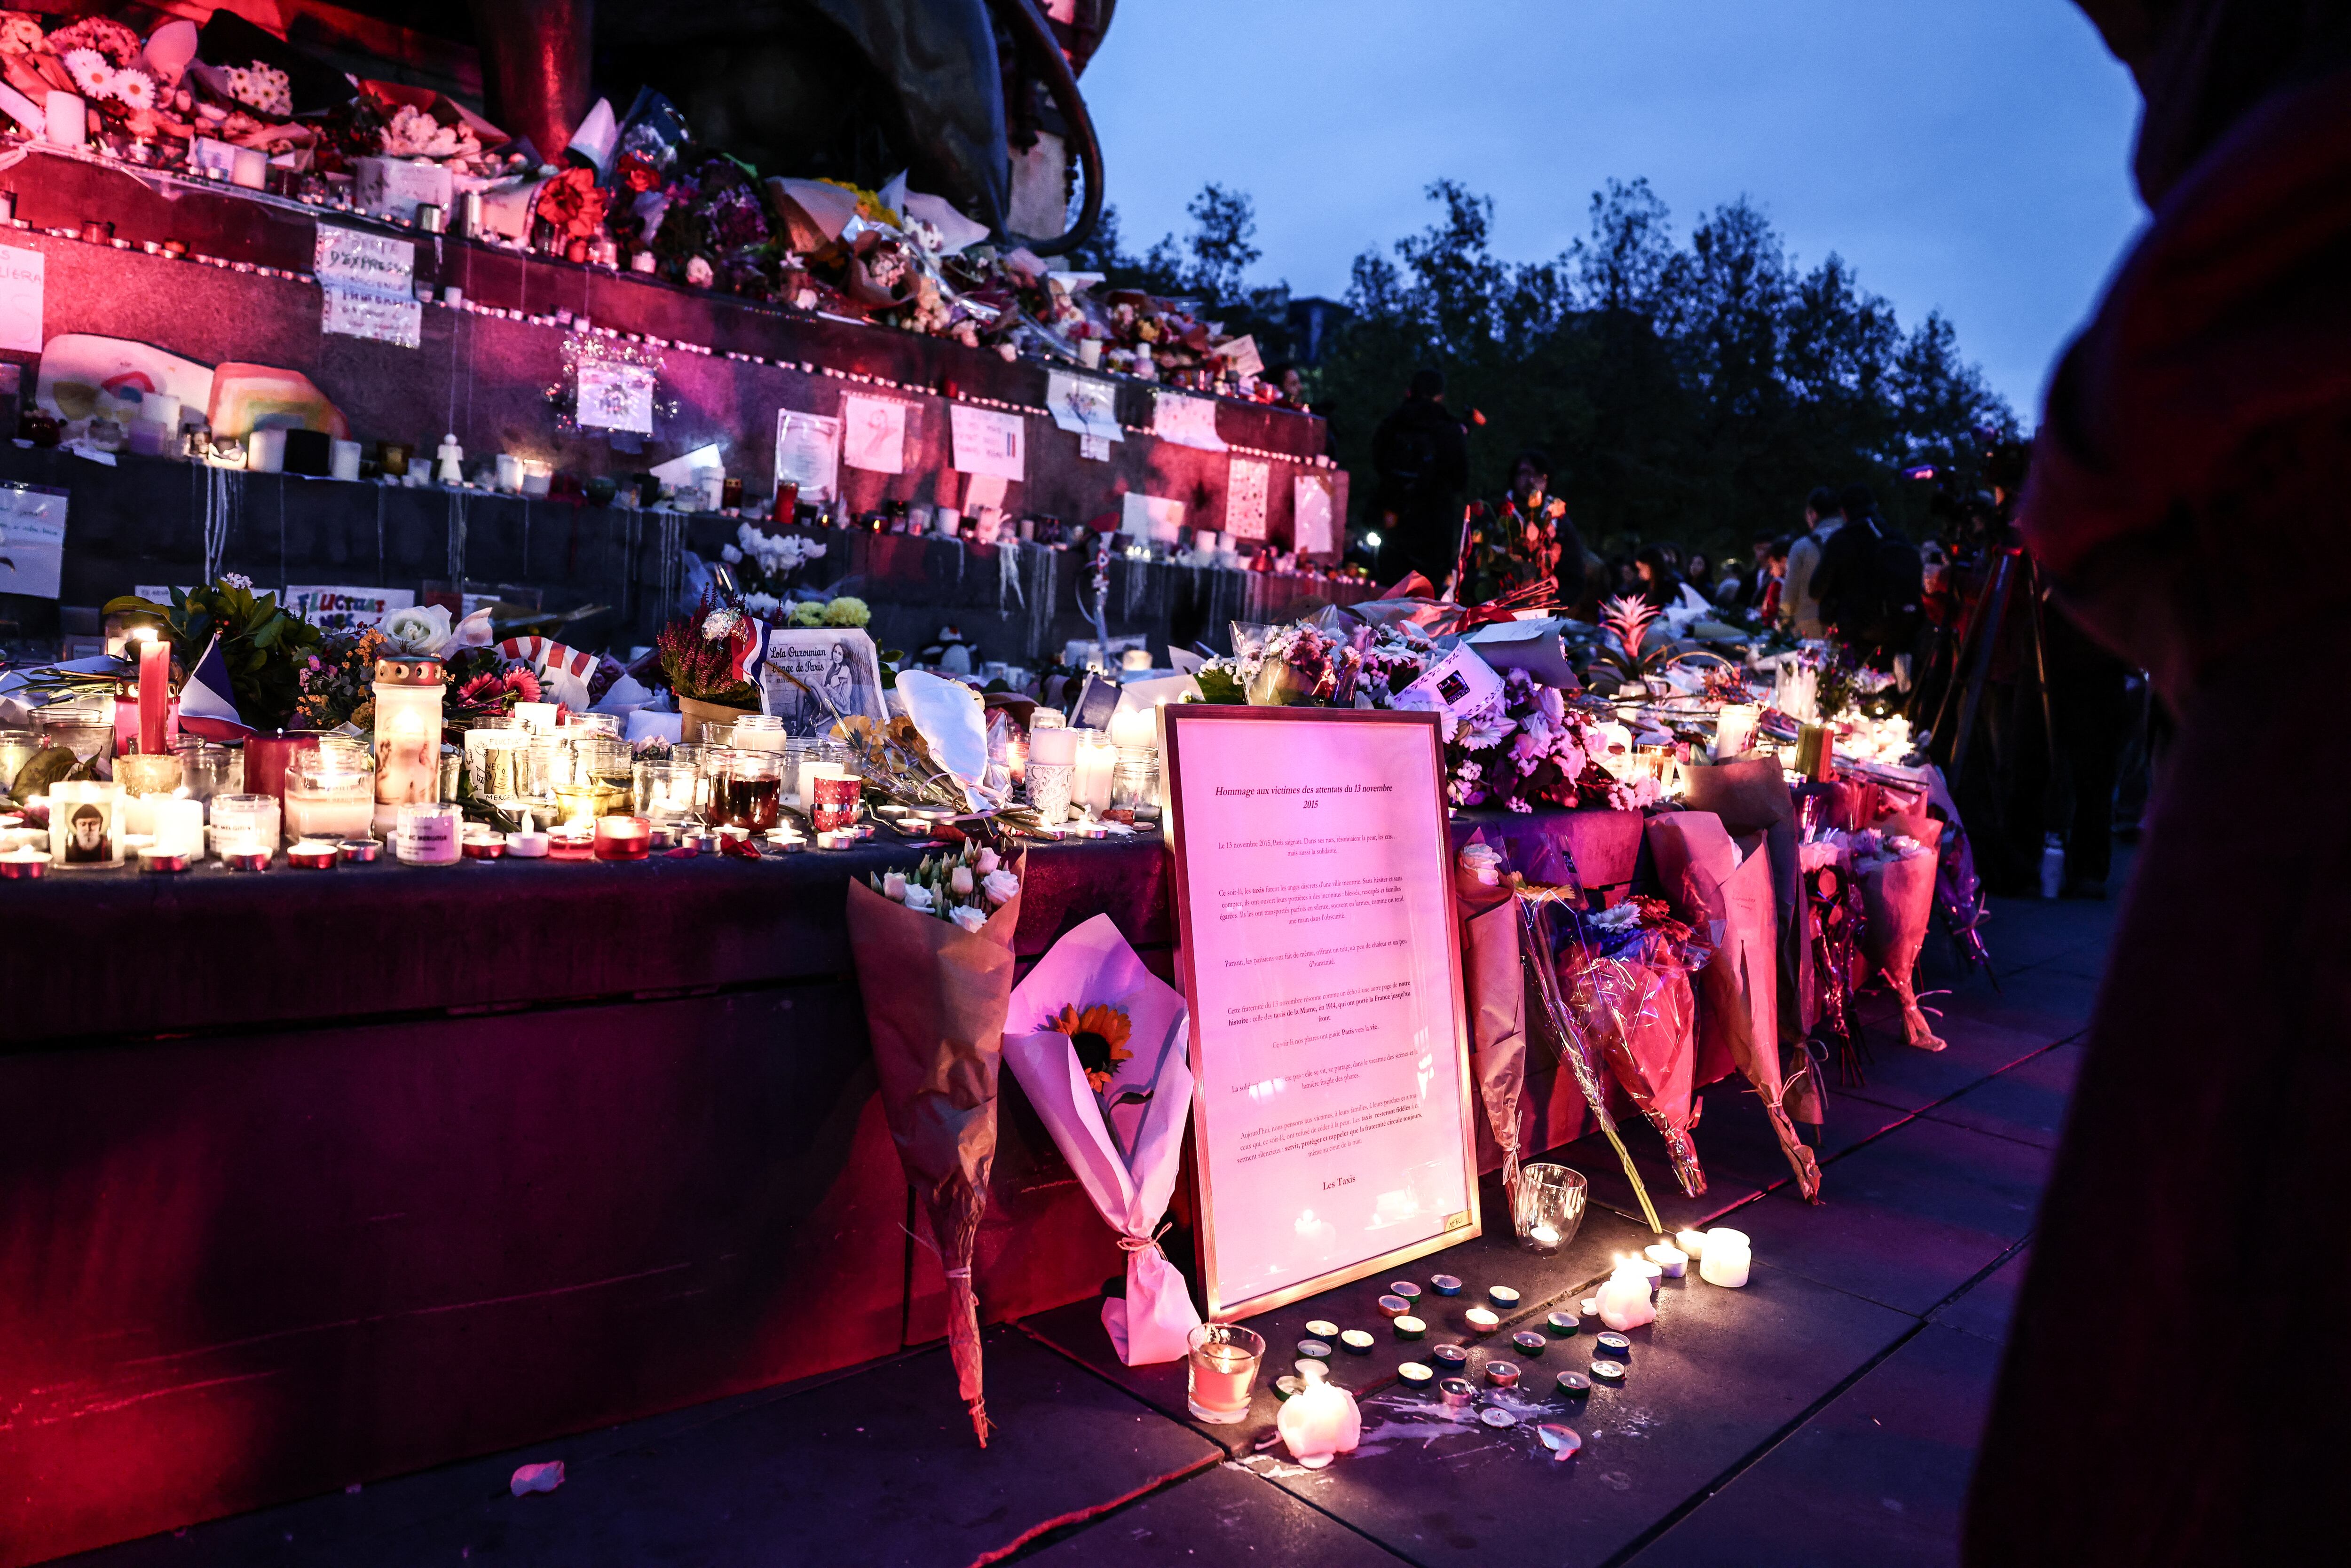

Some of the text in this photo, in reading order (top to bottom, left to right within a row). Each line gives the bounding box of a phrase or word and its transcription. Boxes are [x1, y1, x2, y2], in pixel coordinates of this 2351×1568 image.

[770, 646, 826, 658] Lola Ouzounian
[796, 662, 805, 672] de
[805, 661, 824, 672] Paris
[1215, 787, 1255, 798] Hommage
[1271, 785, 1300, 794] victimes
[1302, 785, 1314, 794] des
[1344, 784, 1352, 793] du
[1354, 784, 1361, 792] 13
[1362, 783, 1393, 792] novembre
[1302, 800, 1318, 809] 2015
[1362, 888, 1380, 896] rescapés
[1253, 956, 1274, 965] parisiens
[1228, 1017, 1248, 1026] histoire
[1338, 1000, 1346, 1009] qui
[1356, 997, 1368, 1007] porté
[1242, 1003, 1263, 1012] fraternité
[1279, 997, 1302, 1006] novembre
[1304, 1035, 1319, 1045] phares
[1328, 1030, 1340, 1040] guidé
[1237, 1154, 1257, 1164] serment
[1258, 1148, 1281, 1158] silencieux
[1285, 1142, 1300, 1151] servir,
[1301, 1137, 1322, 1149] protéger
[1329, 1130, 1349, 1141] rappeler
[1365, 1120, 1386, 1131] fraternité
[1387, 1117, 1403, 1126] circule
[1322, 1174, 1356, 1190] Les Taxis
[1449, 1215, 1463, 1229] MERCI
